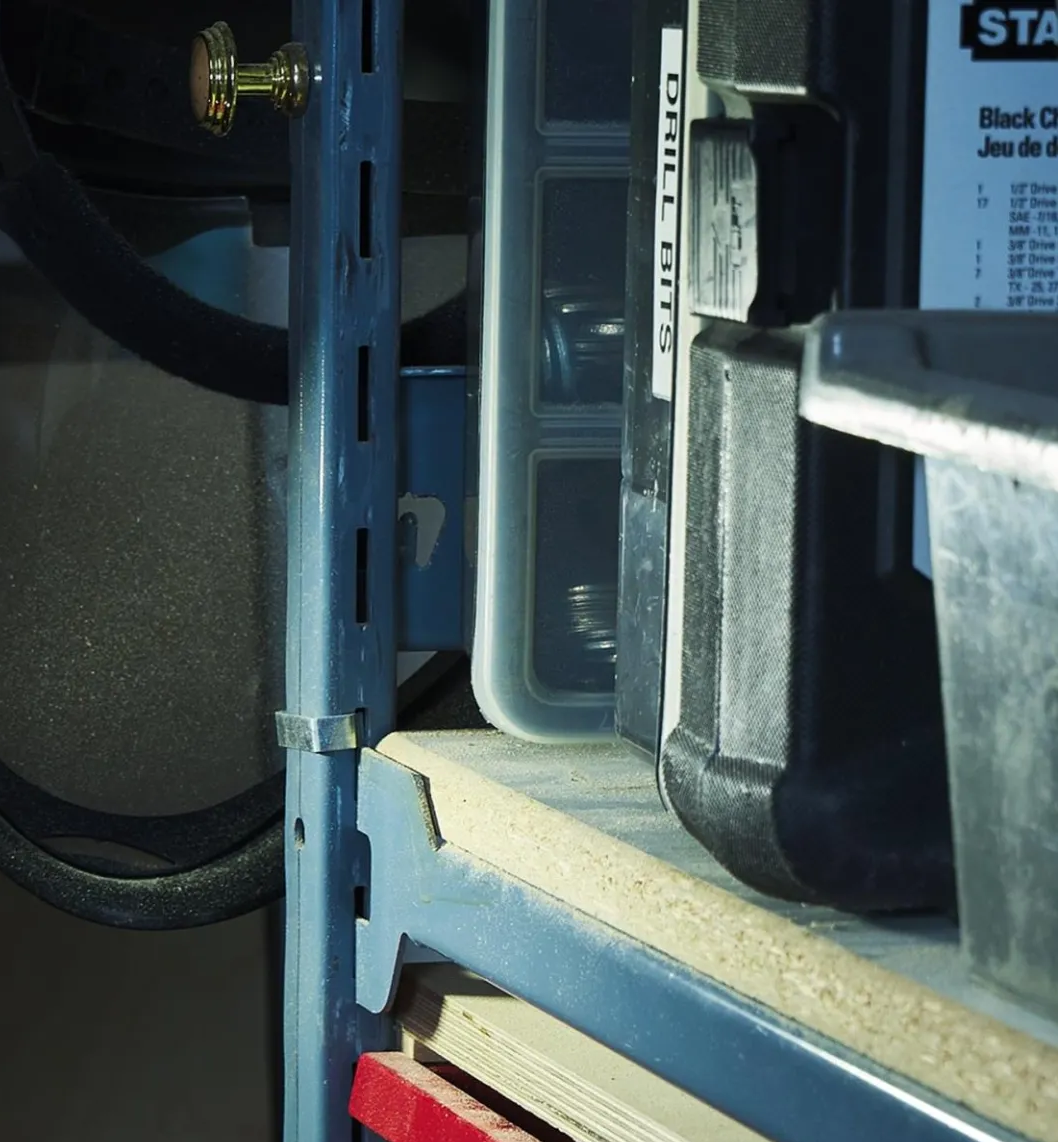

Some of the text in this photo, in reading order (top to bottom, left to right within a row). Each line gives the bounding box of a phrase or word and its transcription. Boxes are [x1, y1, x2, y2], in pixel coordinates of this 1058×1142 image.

[978, 8, 1058, 46] STA
[979, 106, 1035, 130] Black
[977, 135, 1014, 159] Jeu
[1017, 134, 1042, 159] de
[1030, 182, 1057, 195] Drive
[977, 197, 988, 209] 17
[1029, 196, 1057, 209] Drive
[658, 73, 680, 356] DRILL BITS
[1008, 210, 1030, 223] SAE
[1008, 225, 1030, 236] MM
[1029, 239, 1055, 251] Drive
[1028, 253, 1055, 265] Drive
[1027, 267, 1054, 280] Drive
[1027, 295, 1054, 308] Drive
